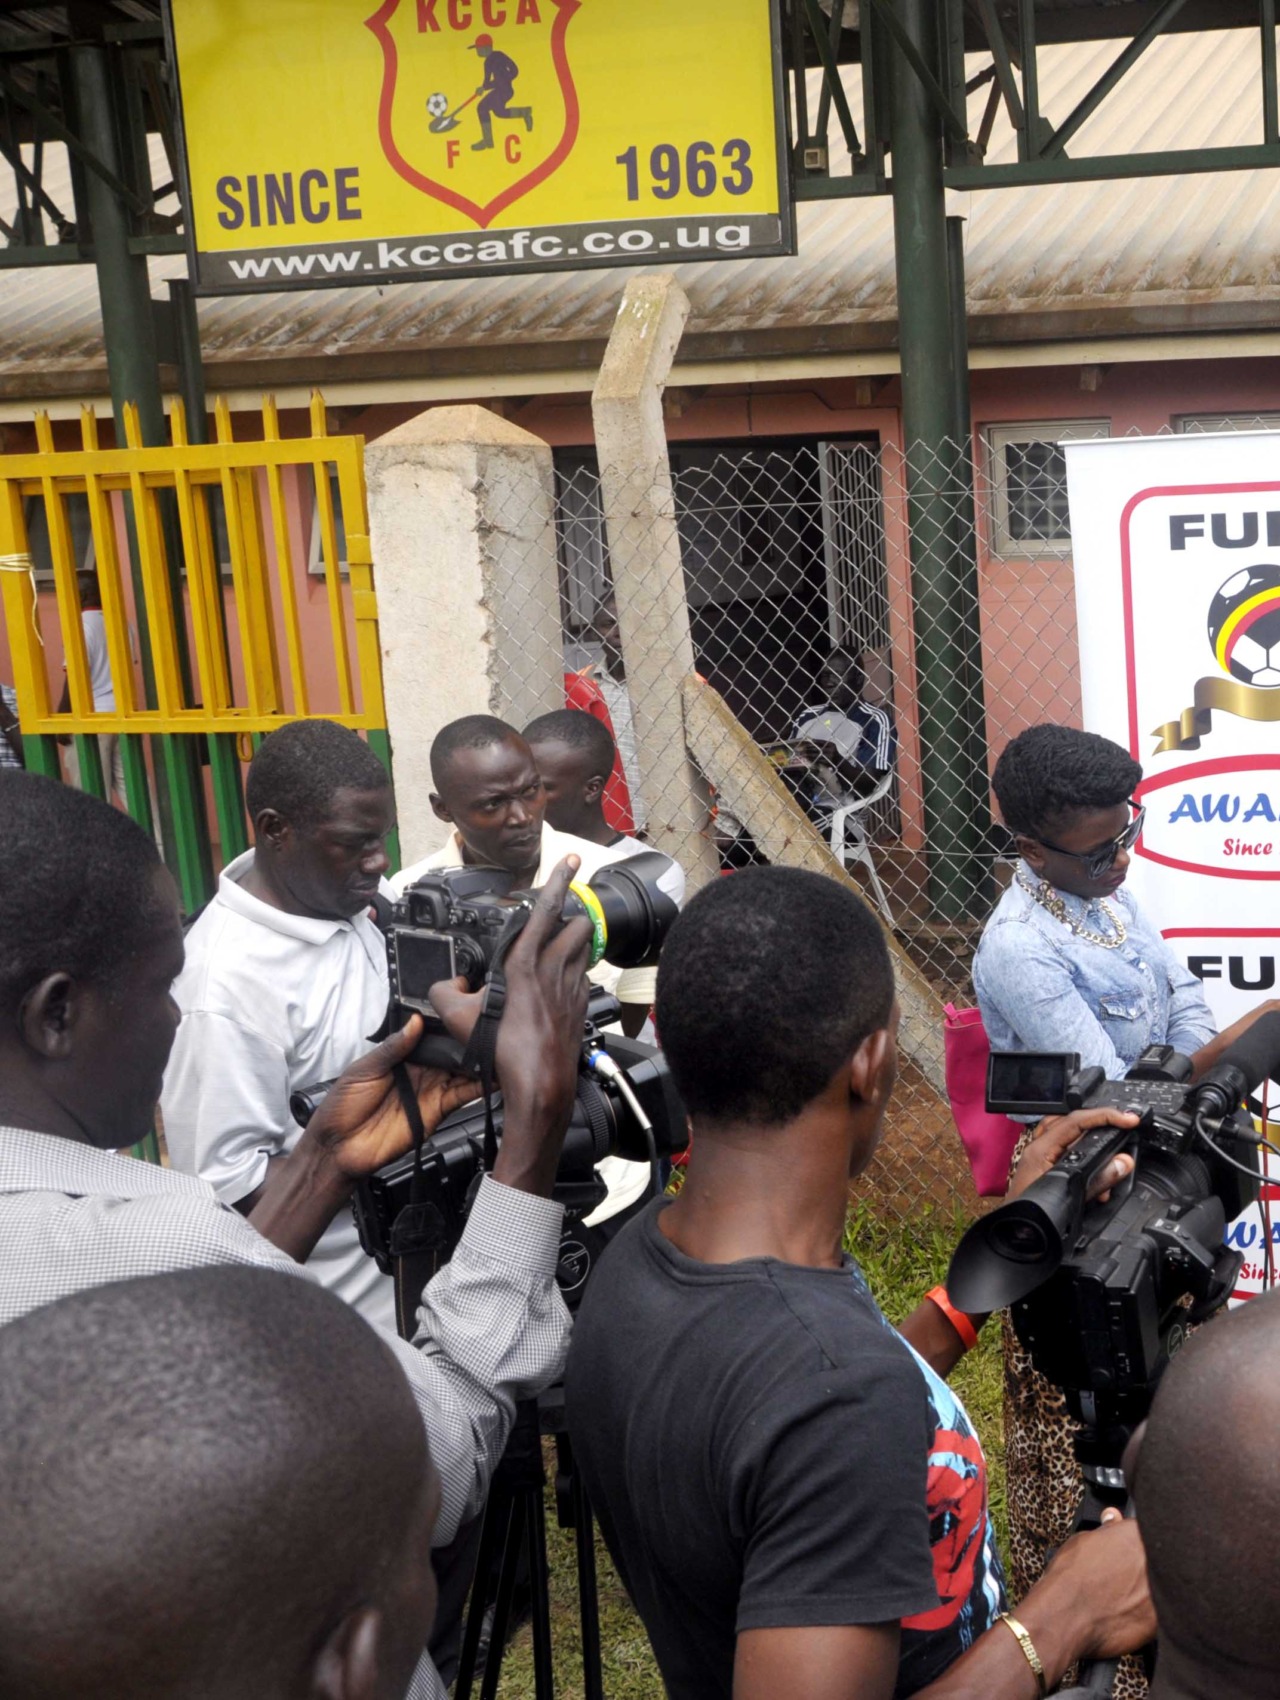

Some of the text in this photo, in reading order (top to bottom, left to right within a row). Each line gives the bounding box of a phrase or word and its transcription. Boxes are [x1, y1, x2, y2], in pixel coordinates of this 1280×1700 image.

[416, 0, 542, 33] KCCA
[446, 134, 522, 169] F C
[216, 138, 754, 230] SINCE 1963
[228, 225, 751, 279] www.kccafc.co.ug
[1223, 837, 1274, 857] Since
